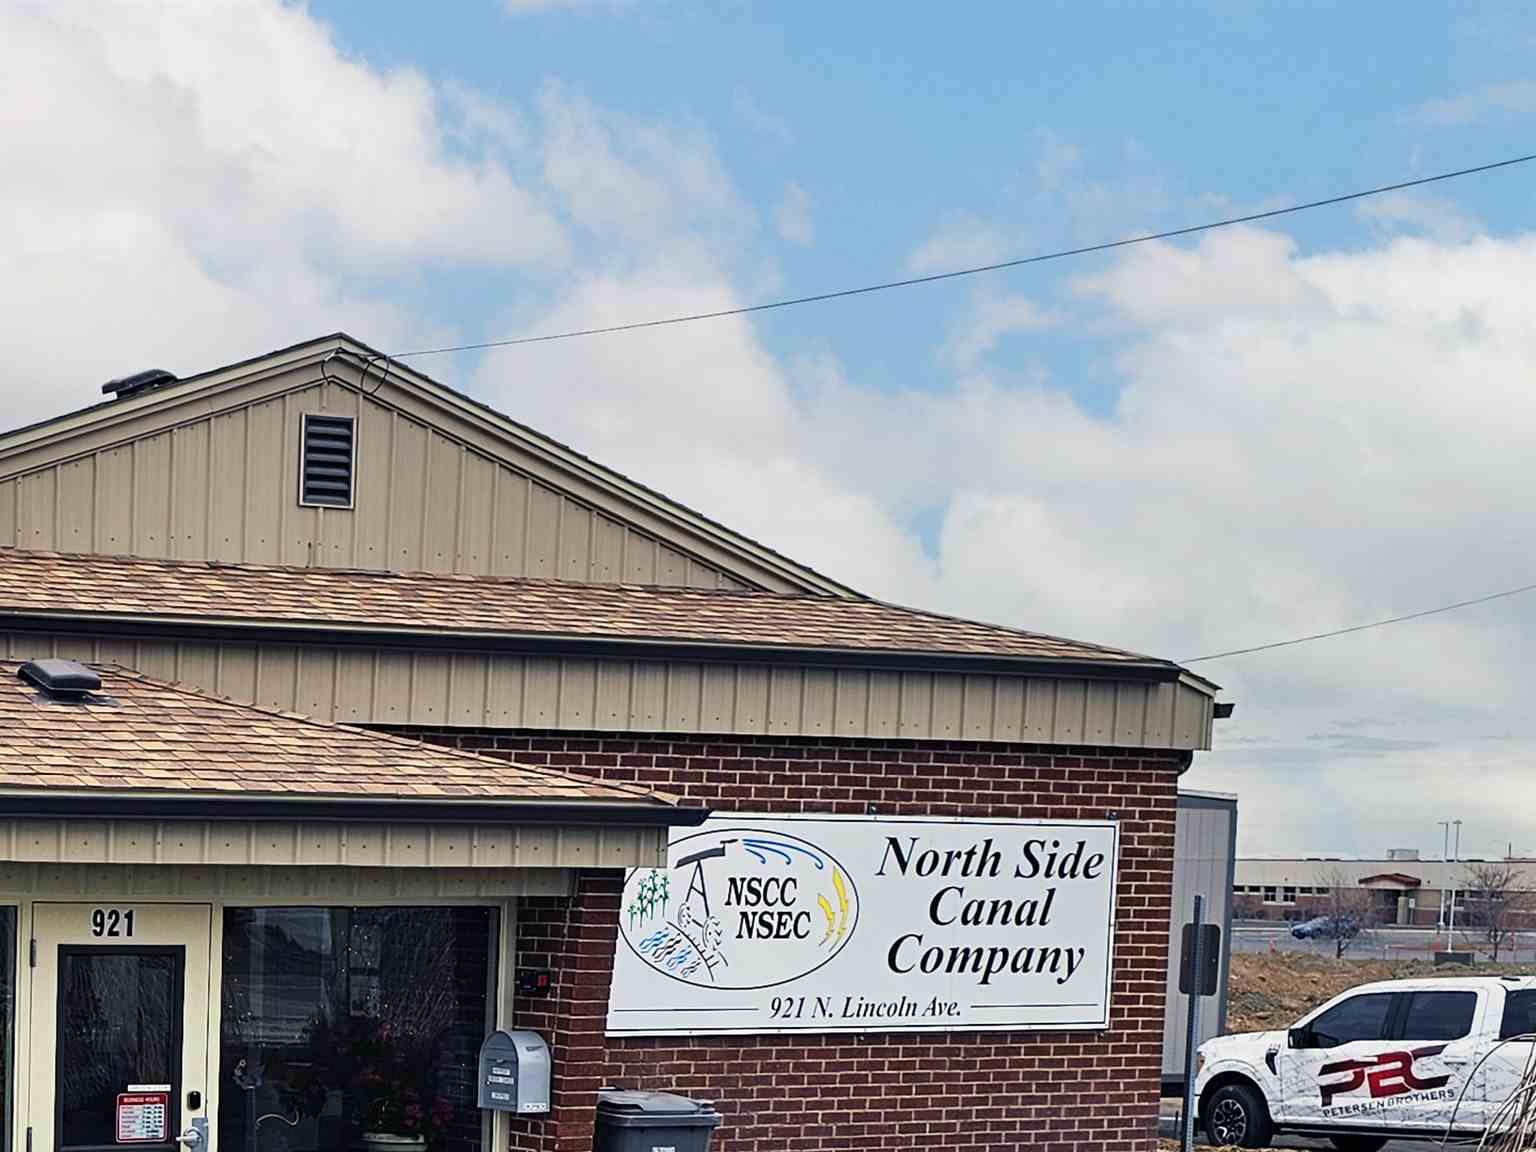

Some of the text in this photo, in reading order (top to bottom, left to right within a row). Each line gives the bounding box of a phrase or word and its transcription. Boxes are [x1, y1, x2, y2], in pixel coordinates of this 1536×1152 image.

[875, 836, 1105, 880] North Side
[724, 876, 797, 907] NSCC
[928, 886, 1057, 927] Canal
[92, 909, 134, 937] 921
[735, 910, 811, 940] NSEC
[887, 933, 1085, 985] Company
[769, 995, 962, 1019] 921 N. Lincoln Ave.
[1322, 1100, 1385, 1118] PETERSEN
[1387, 1089, 1455, 1107] BROTHERS
